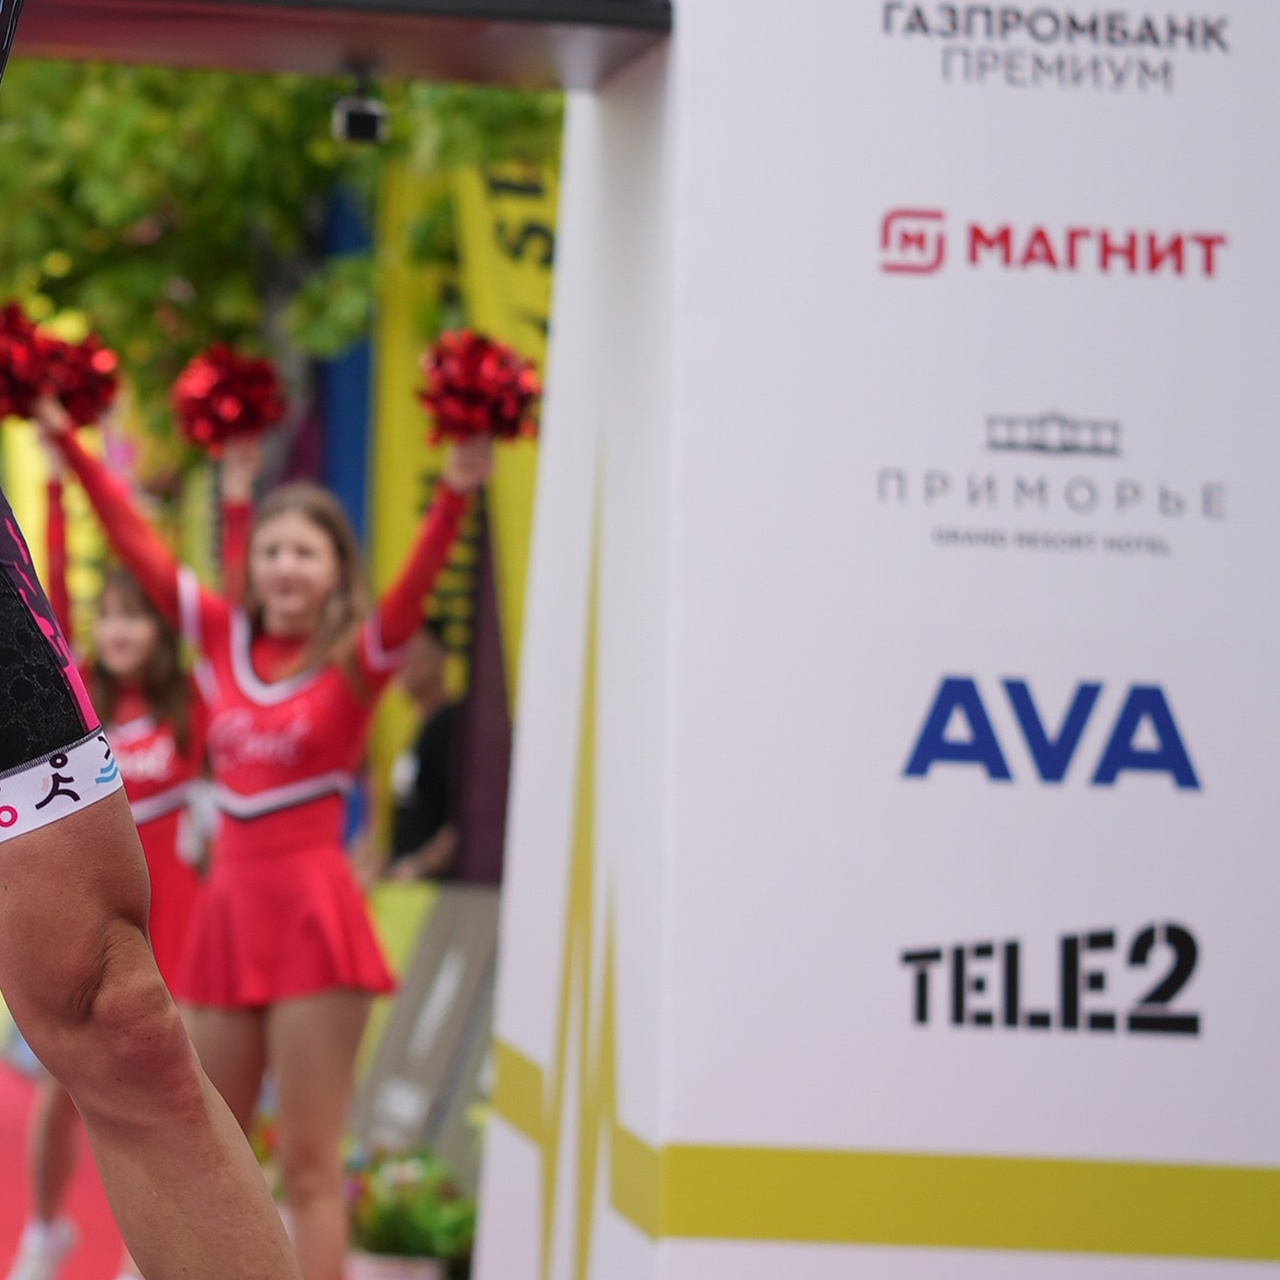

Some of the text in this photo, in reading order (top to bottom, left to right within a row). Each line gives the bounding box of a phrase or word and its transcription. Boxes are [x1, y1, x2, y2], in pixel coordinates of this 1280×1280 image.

[881, 1, 1230, 55] ГАЗПРОМБАНК
[941, 44, 1174, 94] ПРЕМИУМ
[966, 220, 1228, 279] МАГНИТ
[877, 466, 1228, 520] ПРИМОРЬЕ
[902, 674, 1203, 791] AVA
[901, 922, 1202, 1036] TELE2
